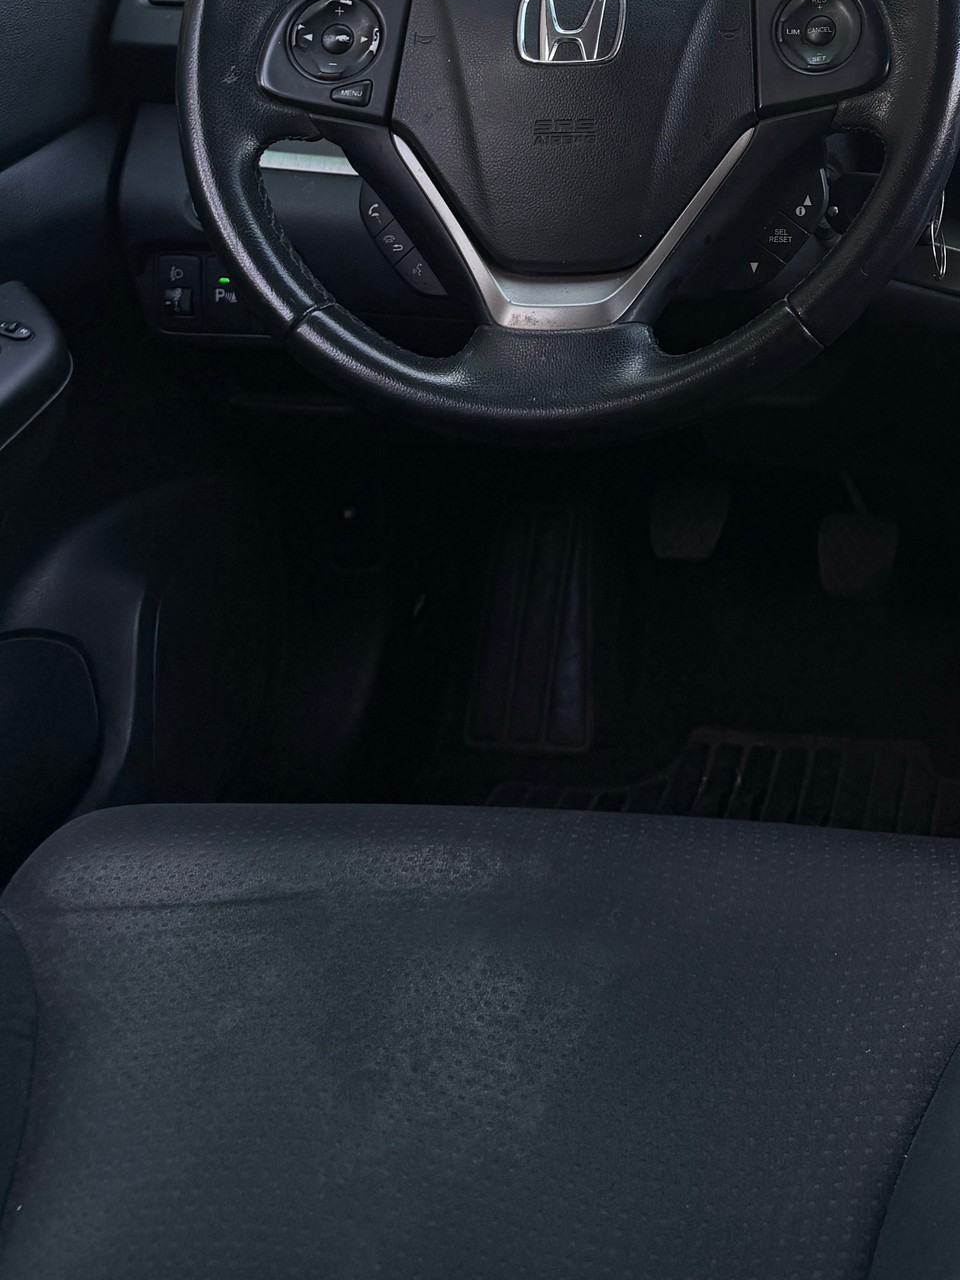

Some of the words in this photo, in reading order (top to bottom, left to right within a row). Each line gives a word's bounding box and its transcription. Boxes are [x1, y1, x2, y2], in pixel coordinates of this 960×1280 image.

[807, 26, 833, 35] CANCEL
[340, 89, 363, 97] MENU
[774, 228, 789, 236] SEL
